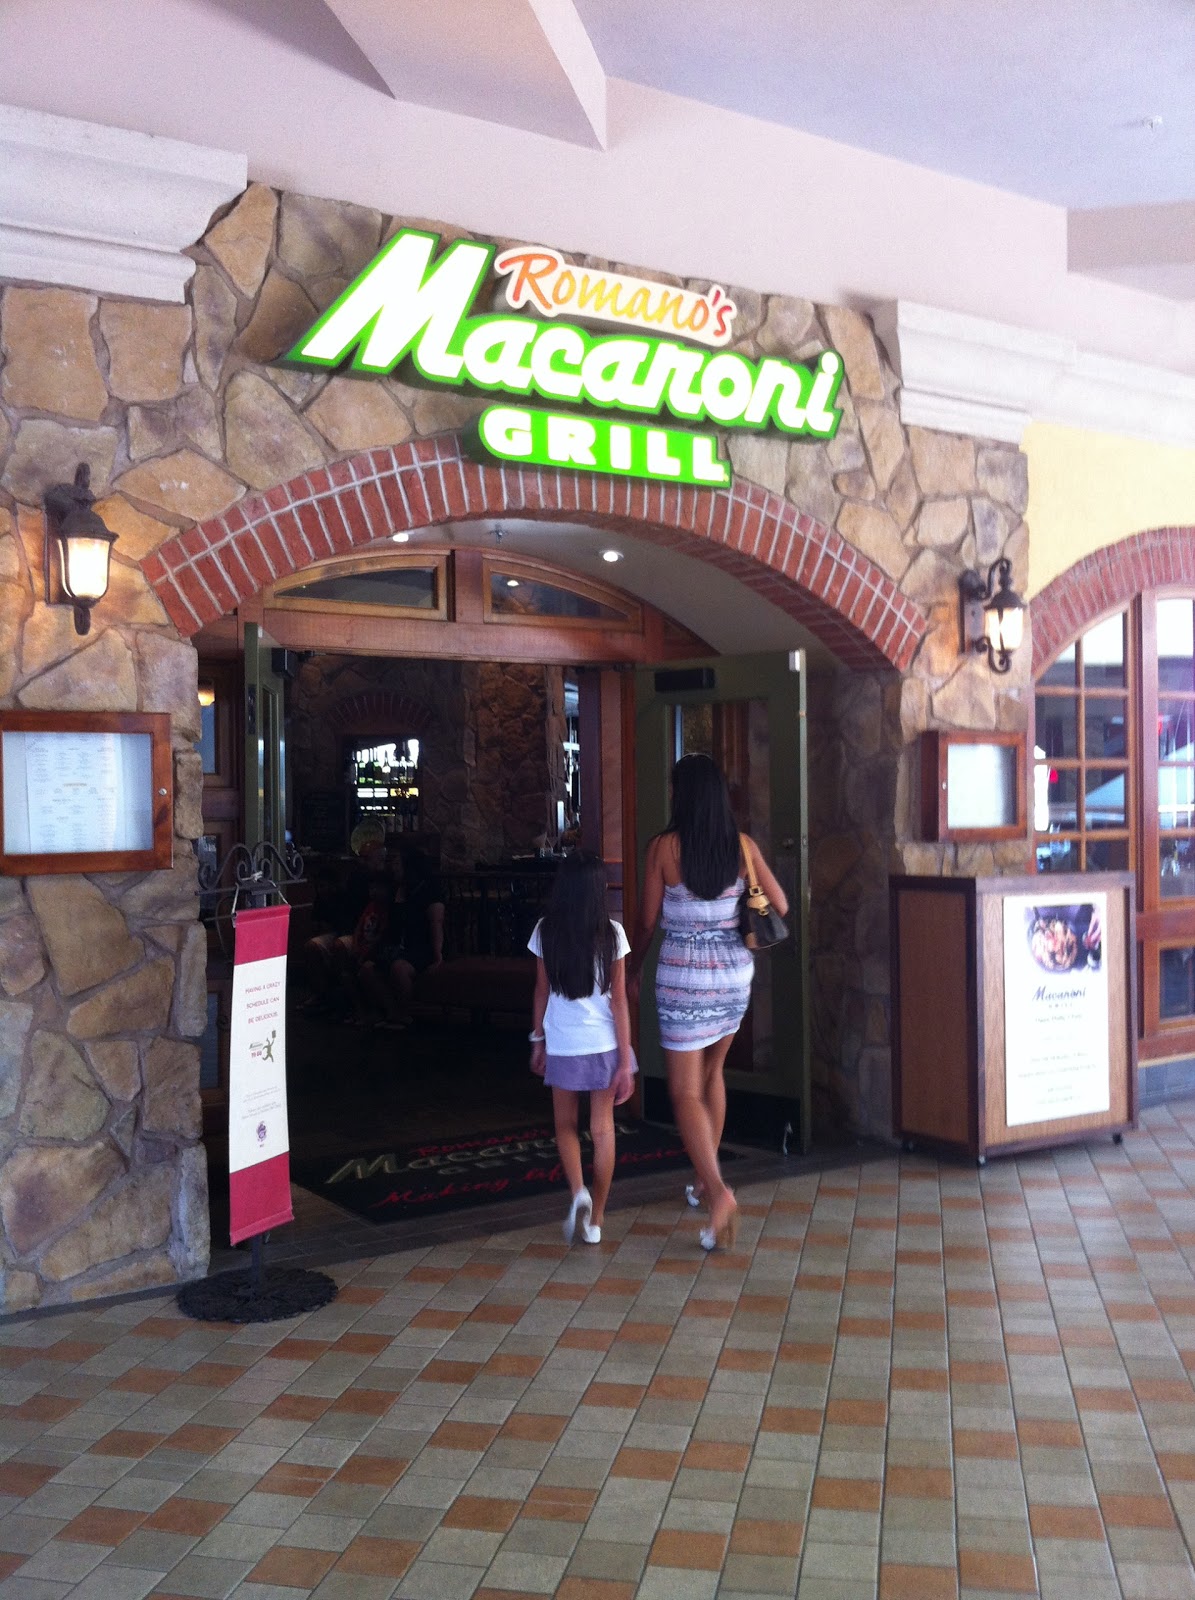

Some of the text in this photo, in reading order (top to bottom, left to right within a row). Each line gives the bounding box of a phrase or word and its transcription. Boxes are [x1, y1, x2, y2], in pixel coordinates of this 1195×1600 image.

[499, 253, 732, 337] Romano's
[300, 231, 841, 434] Macaroni
[482, 408, 727, 482] GRILL
[246, 998, 269, 1009] SCHEDULE
[266, 981, 280, 990] CRAZY
